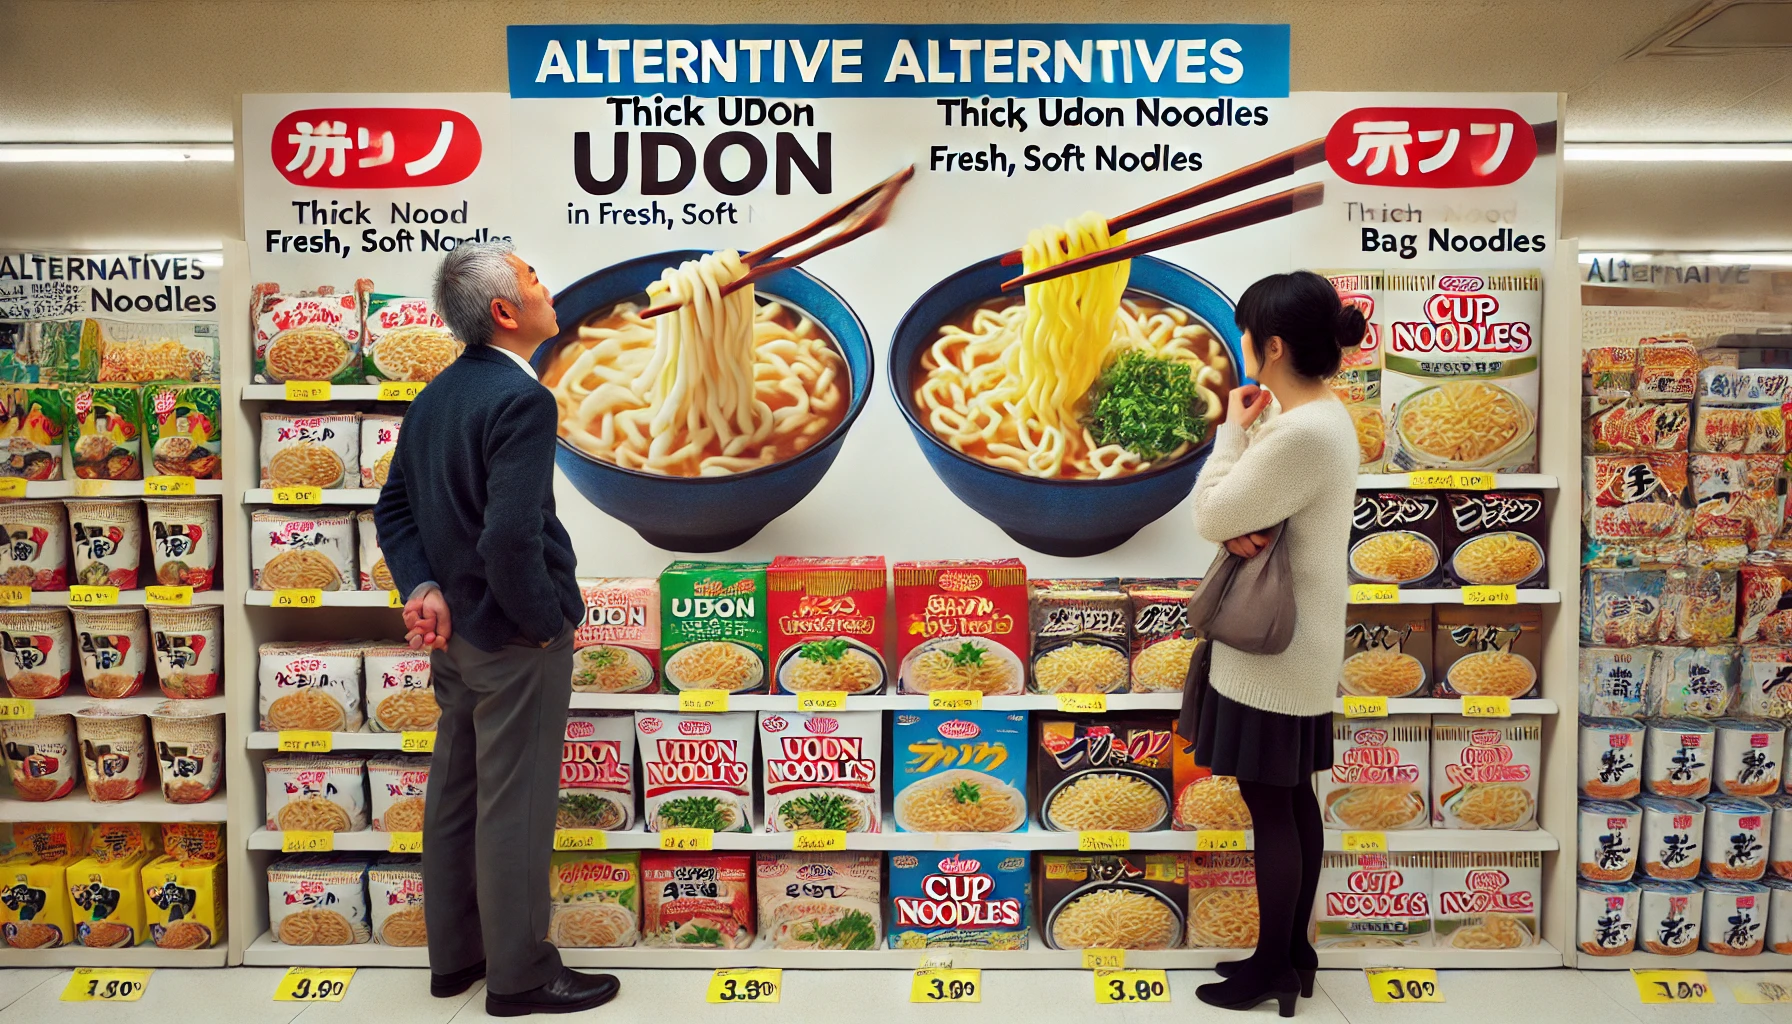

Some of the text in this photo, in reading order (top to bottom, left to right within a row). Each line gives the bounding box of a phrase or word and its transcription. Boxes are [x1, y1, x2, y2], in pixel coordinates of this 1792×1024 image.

[535, 38, 1245, 84] ALTERNTIVE ALTERNTIVES
[606, 96, 706, 127] Thick
[937, 98, 1269, 132] Thick Udon Noodles
[574, 131, 832, 196] UDON
[930, 144, 1203, 177] Fresh, Soft Nodles
[292, 200, 468, 226] Thick Nood
[568, 201, 738, 230] in Fresh, Soft
[266, 229, 351, 259] Fresh,
[361, 229, 415, 253] Soft
[1361, 227, 1547, 260] Bag Noodles
[0, 254, 206, 281] ALTERNATIVES
[91, 285, 218, 312] Noodles
[1427, 295, 1497, 324] CUP
[1393, 322, 1531, 352] NOODLES
[924, 875, 992, 902] CUP
[897, 899, 1020, 925] NOODLES
